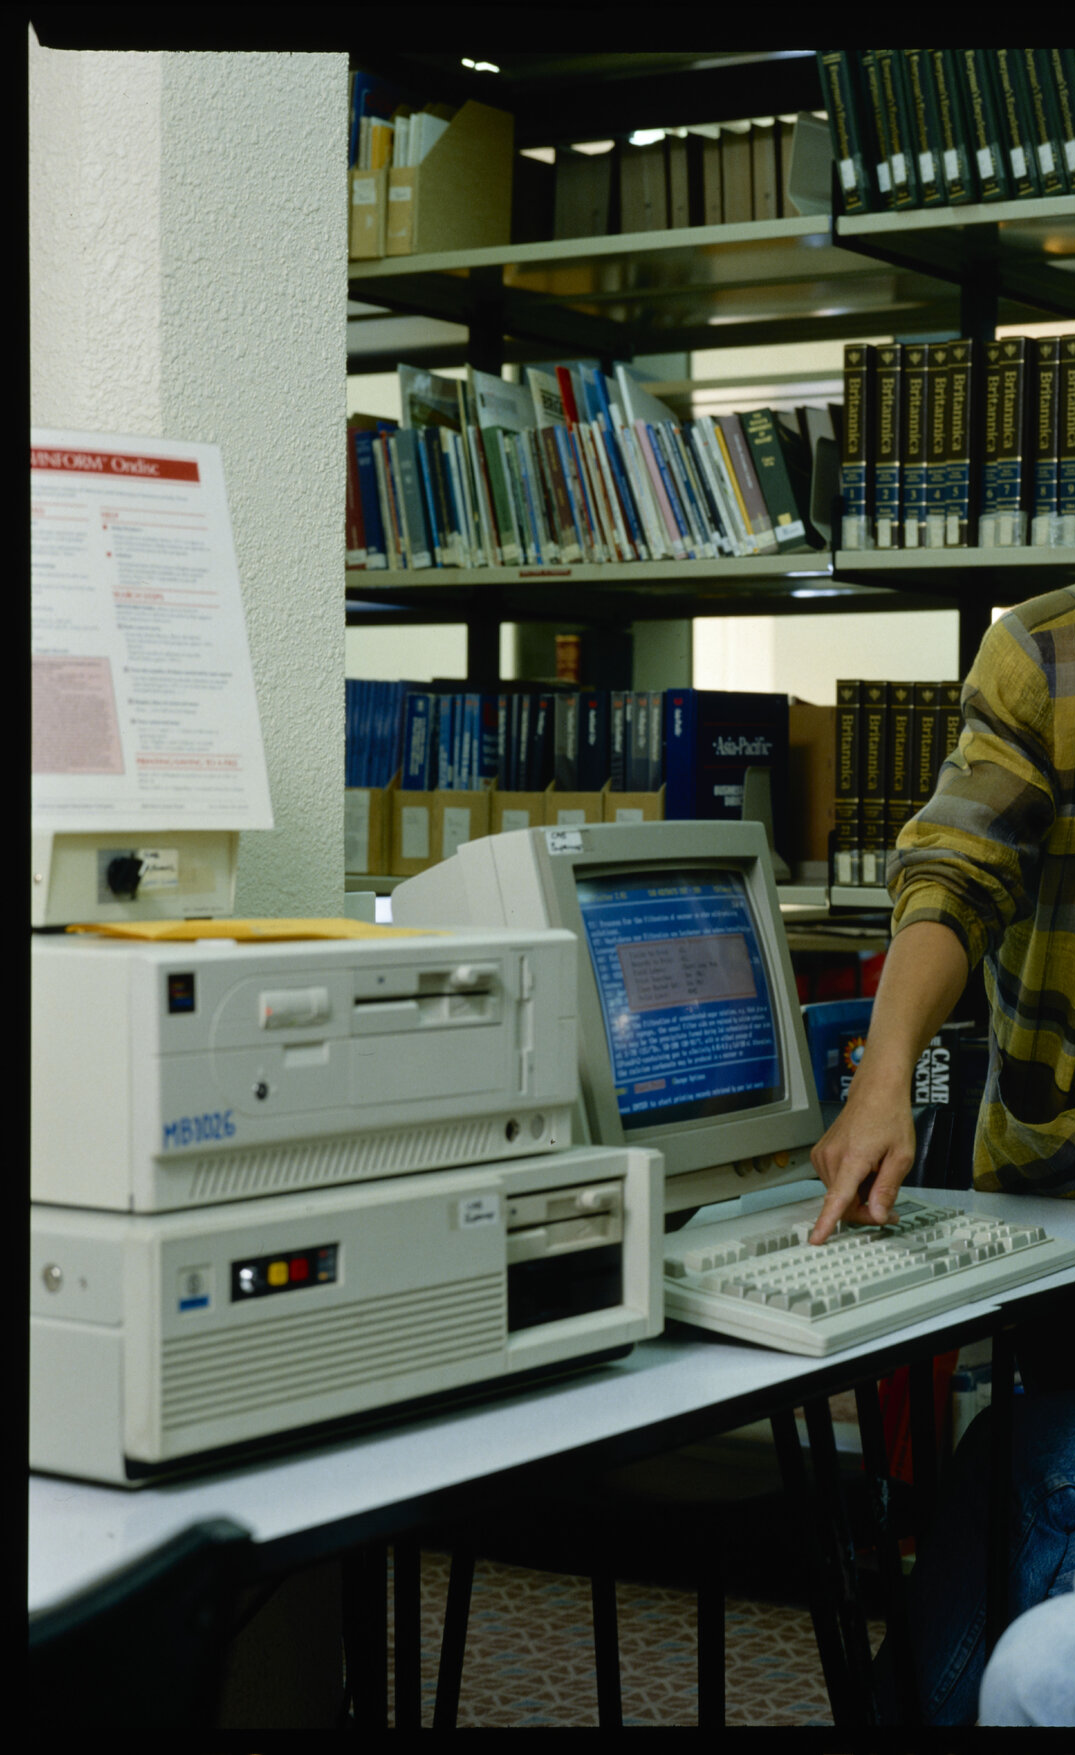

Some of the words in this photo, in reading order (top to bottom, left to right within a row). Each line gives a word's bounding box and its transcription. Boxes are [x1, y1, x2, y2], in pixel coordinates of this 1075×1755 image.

[848, 377, 861, 453] Britannica
[881, 378, 895, 454] Britannica
[909, 378, 922, 455] Britannica
[933, 377, 947, 454] Britannica
[951, 374, 966, 452] Britannica
[986, 376, 1000, 453] Britannica
[1003, 371, 1017, 449] Britannica
[1039, 371, 1053, 450] Britannica
[111, 457, 160, 475] Ondisc
[714, 736, 773, 756] Asia-Pacific
[841, 714, 855, 790] Britannica
[868, 714, 881, 790] Britannica
[893, 715, 908, 791] Britannica
[920, 716, 934, 793] Britannica
[163, 1110, 236, 1149] MB1026
